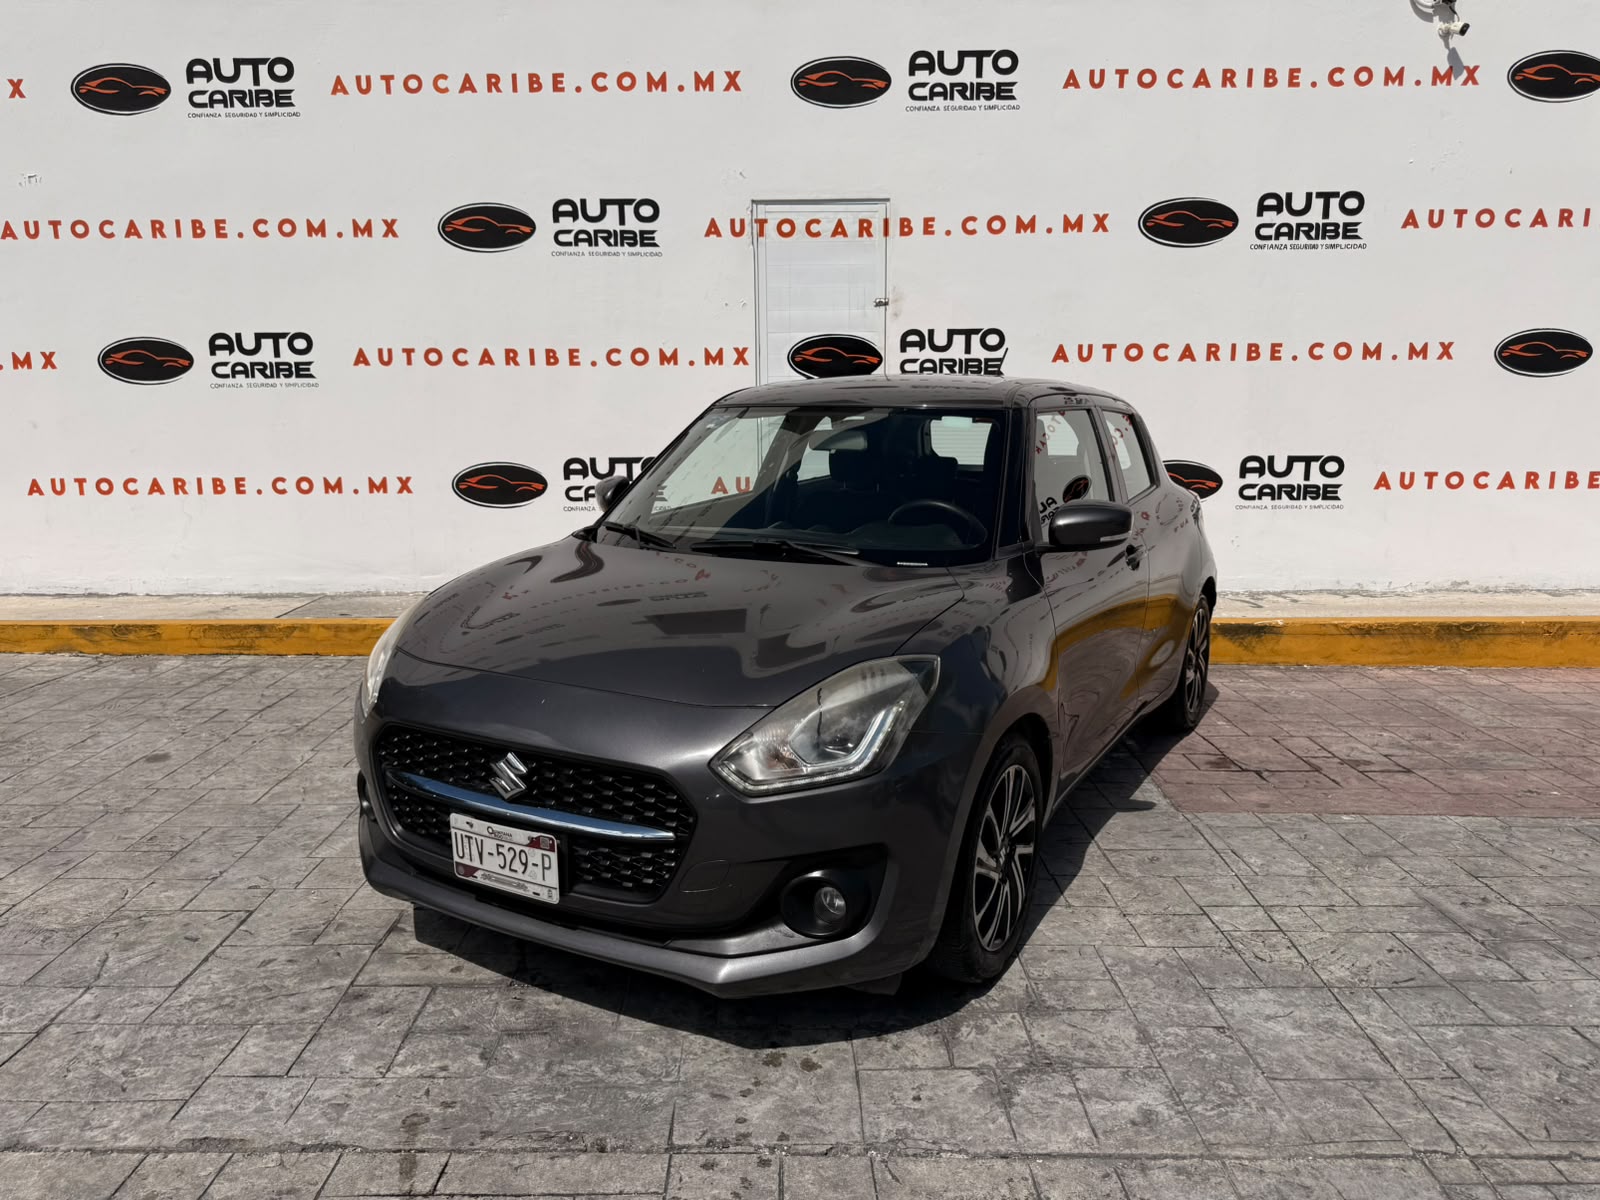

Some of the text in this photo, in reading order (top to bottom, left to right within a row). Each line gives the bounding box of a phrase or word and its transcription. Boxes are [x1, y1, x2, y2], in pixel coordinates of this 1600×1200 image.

[185, 56, 295, 87] AUTO
[908, 49, 1019, 79] AUTO
[330, 69, 743, 97] AUTOCARIBE.COM.MX
[1063, 64, 1481, 91] AUTOCARIBE.COM.MX
[188, 88, 296, 109] CARIBE
[908, 81, 1018, 102] CARIBE
[224, 111, 258, 119] SEGURIDAD
[905, 105, 941, 113] CONFIANZA
[984, 103, 1021, 111] SIMPLICIDAD
[552, 198, 660, 227] AUTO
[1256, 190, 1366, 220] AUTO
[0, 217, 399, 241] AUTOCARIBE.COM.MX
[704, 212, 1110, 240] AUTOCARIBE.COM.MX
[1254, 221, 1363, 241] CARIBE
[553, 228, 661, 248] CARIBE
[1249, 243, 1288, 251] CONFIANZA
[208, 331, 314, 359] AUTO
[899, 327, 1006, 355] AUTO
[1051, 341, 1455, 364] AUTOCARIBE.COM.MX
[353, 346, 749, 368] AUTOCARIBE.COM.MX
[899, 357, 1005, 377] CARIBE
[210, 360, 317, 379] CARIBE
[1238, 454, 1345, 482] AUTO
[27, 475, 414, 498] AUTOCARIBE.COM.MX
[1237, 483, 1344, 501] CARIBE
[454, 831, 552, 882] UTV-529-P
